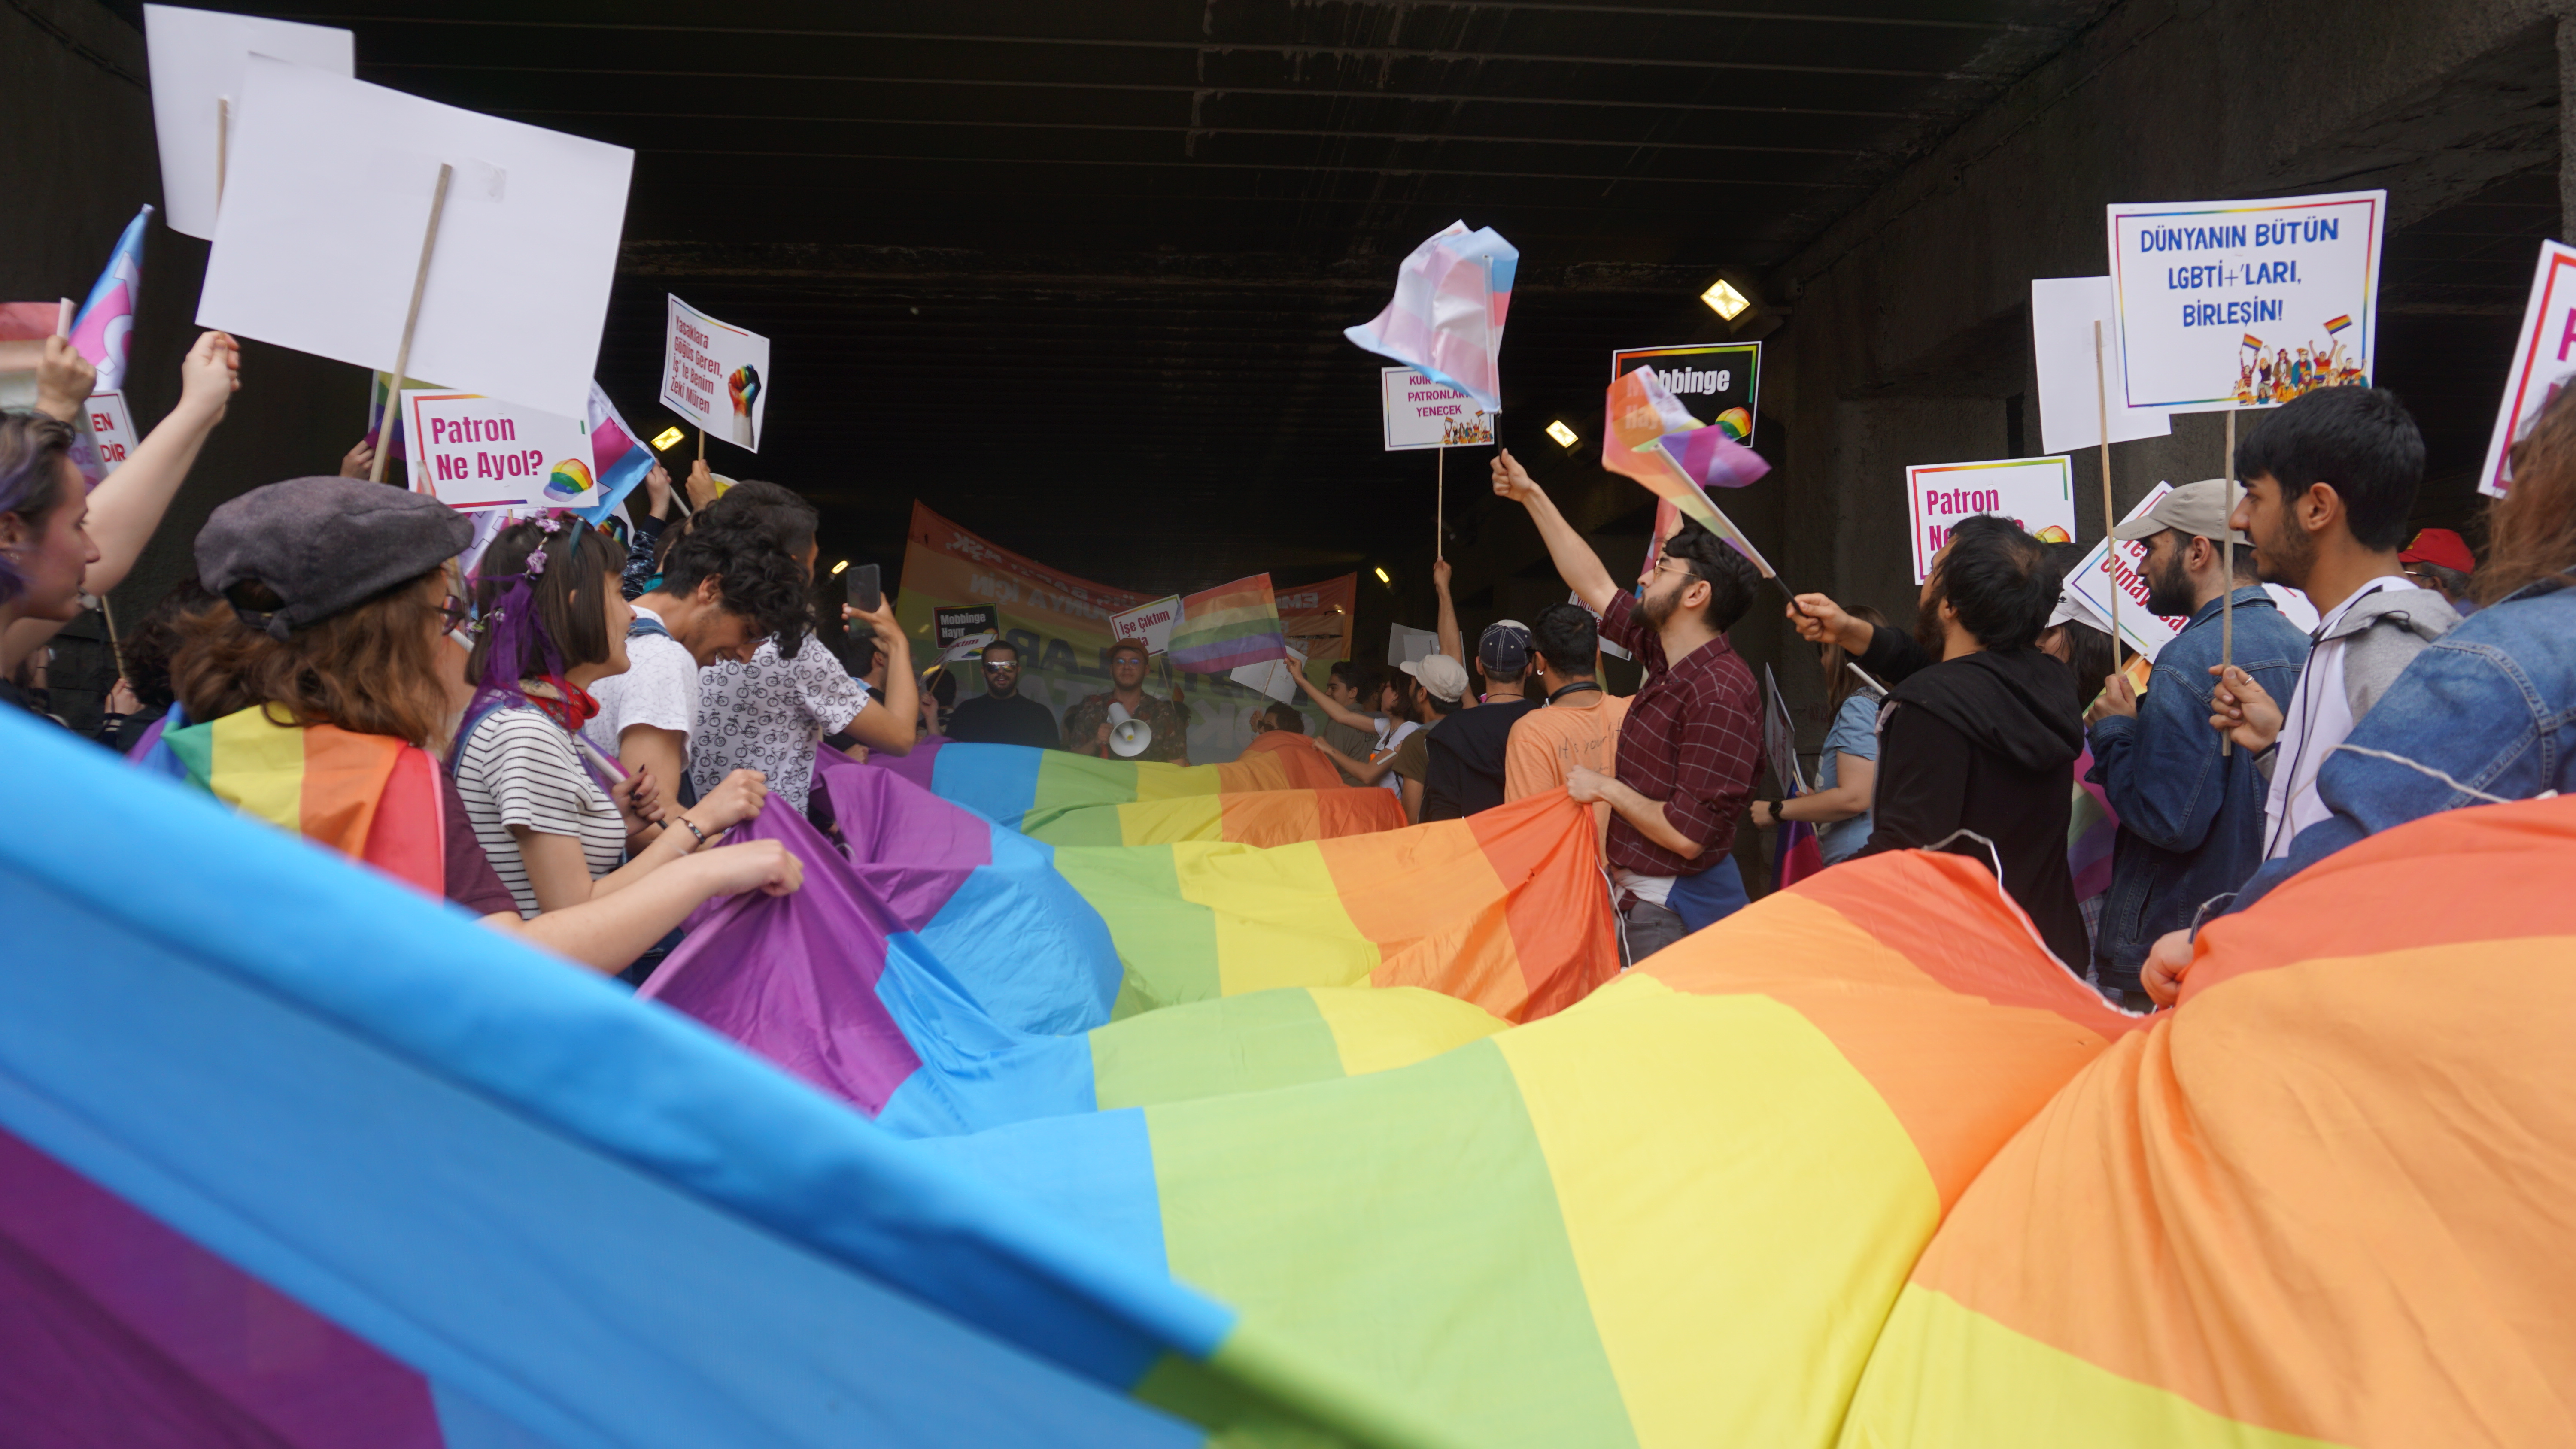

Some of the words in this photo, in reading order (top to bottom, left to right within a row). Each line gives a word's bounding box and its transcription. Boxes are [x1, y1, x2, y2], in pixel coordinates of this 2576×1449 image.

[2141, 225, 2247, 252] DÜNYANIN
[2255, 216, 2339, 247] BÜTÜN
[2169, 259, 2301, 289] LGBTİ+'LARI,
[2183, 295, 2283, 327] BİRLEŞİN!
[675, 315, 709, 349] Yasaklara
[674, 336, 694, 362] Göğüs
[696, 350, 722, 379] Geren,
[670, 376, 685, 399] Zeki
[686, 385, 710, 414] Müren
[690, 368, 714, 395] Benim
[1416, 404, 1462, 418] YENECEK
[431, 416, 516, 444] Patron
[435, 454, 468, 480] Ne
[477, 450, 543, 481] Ayol?
[1926, 488, 1999, 515] Patron
[940, 612, 986, 626] Mobbinge
[1119, 621, 1136, 637] İşe
[1137, 611, 1170, 633] Çıktım
